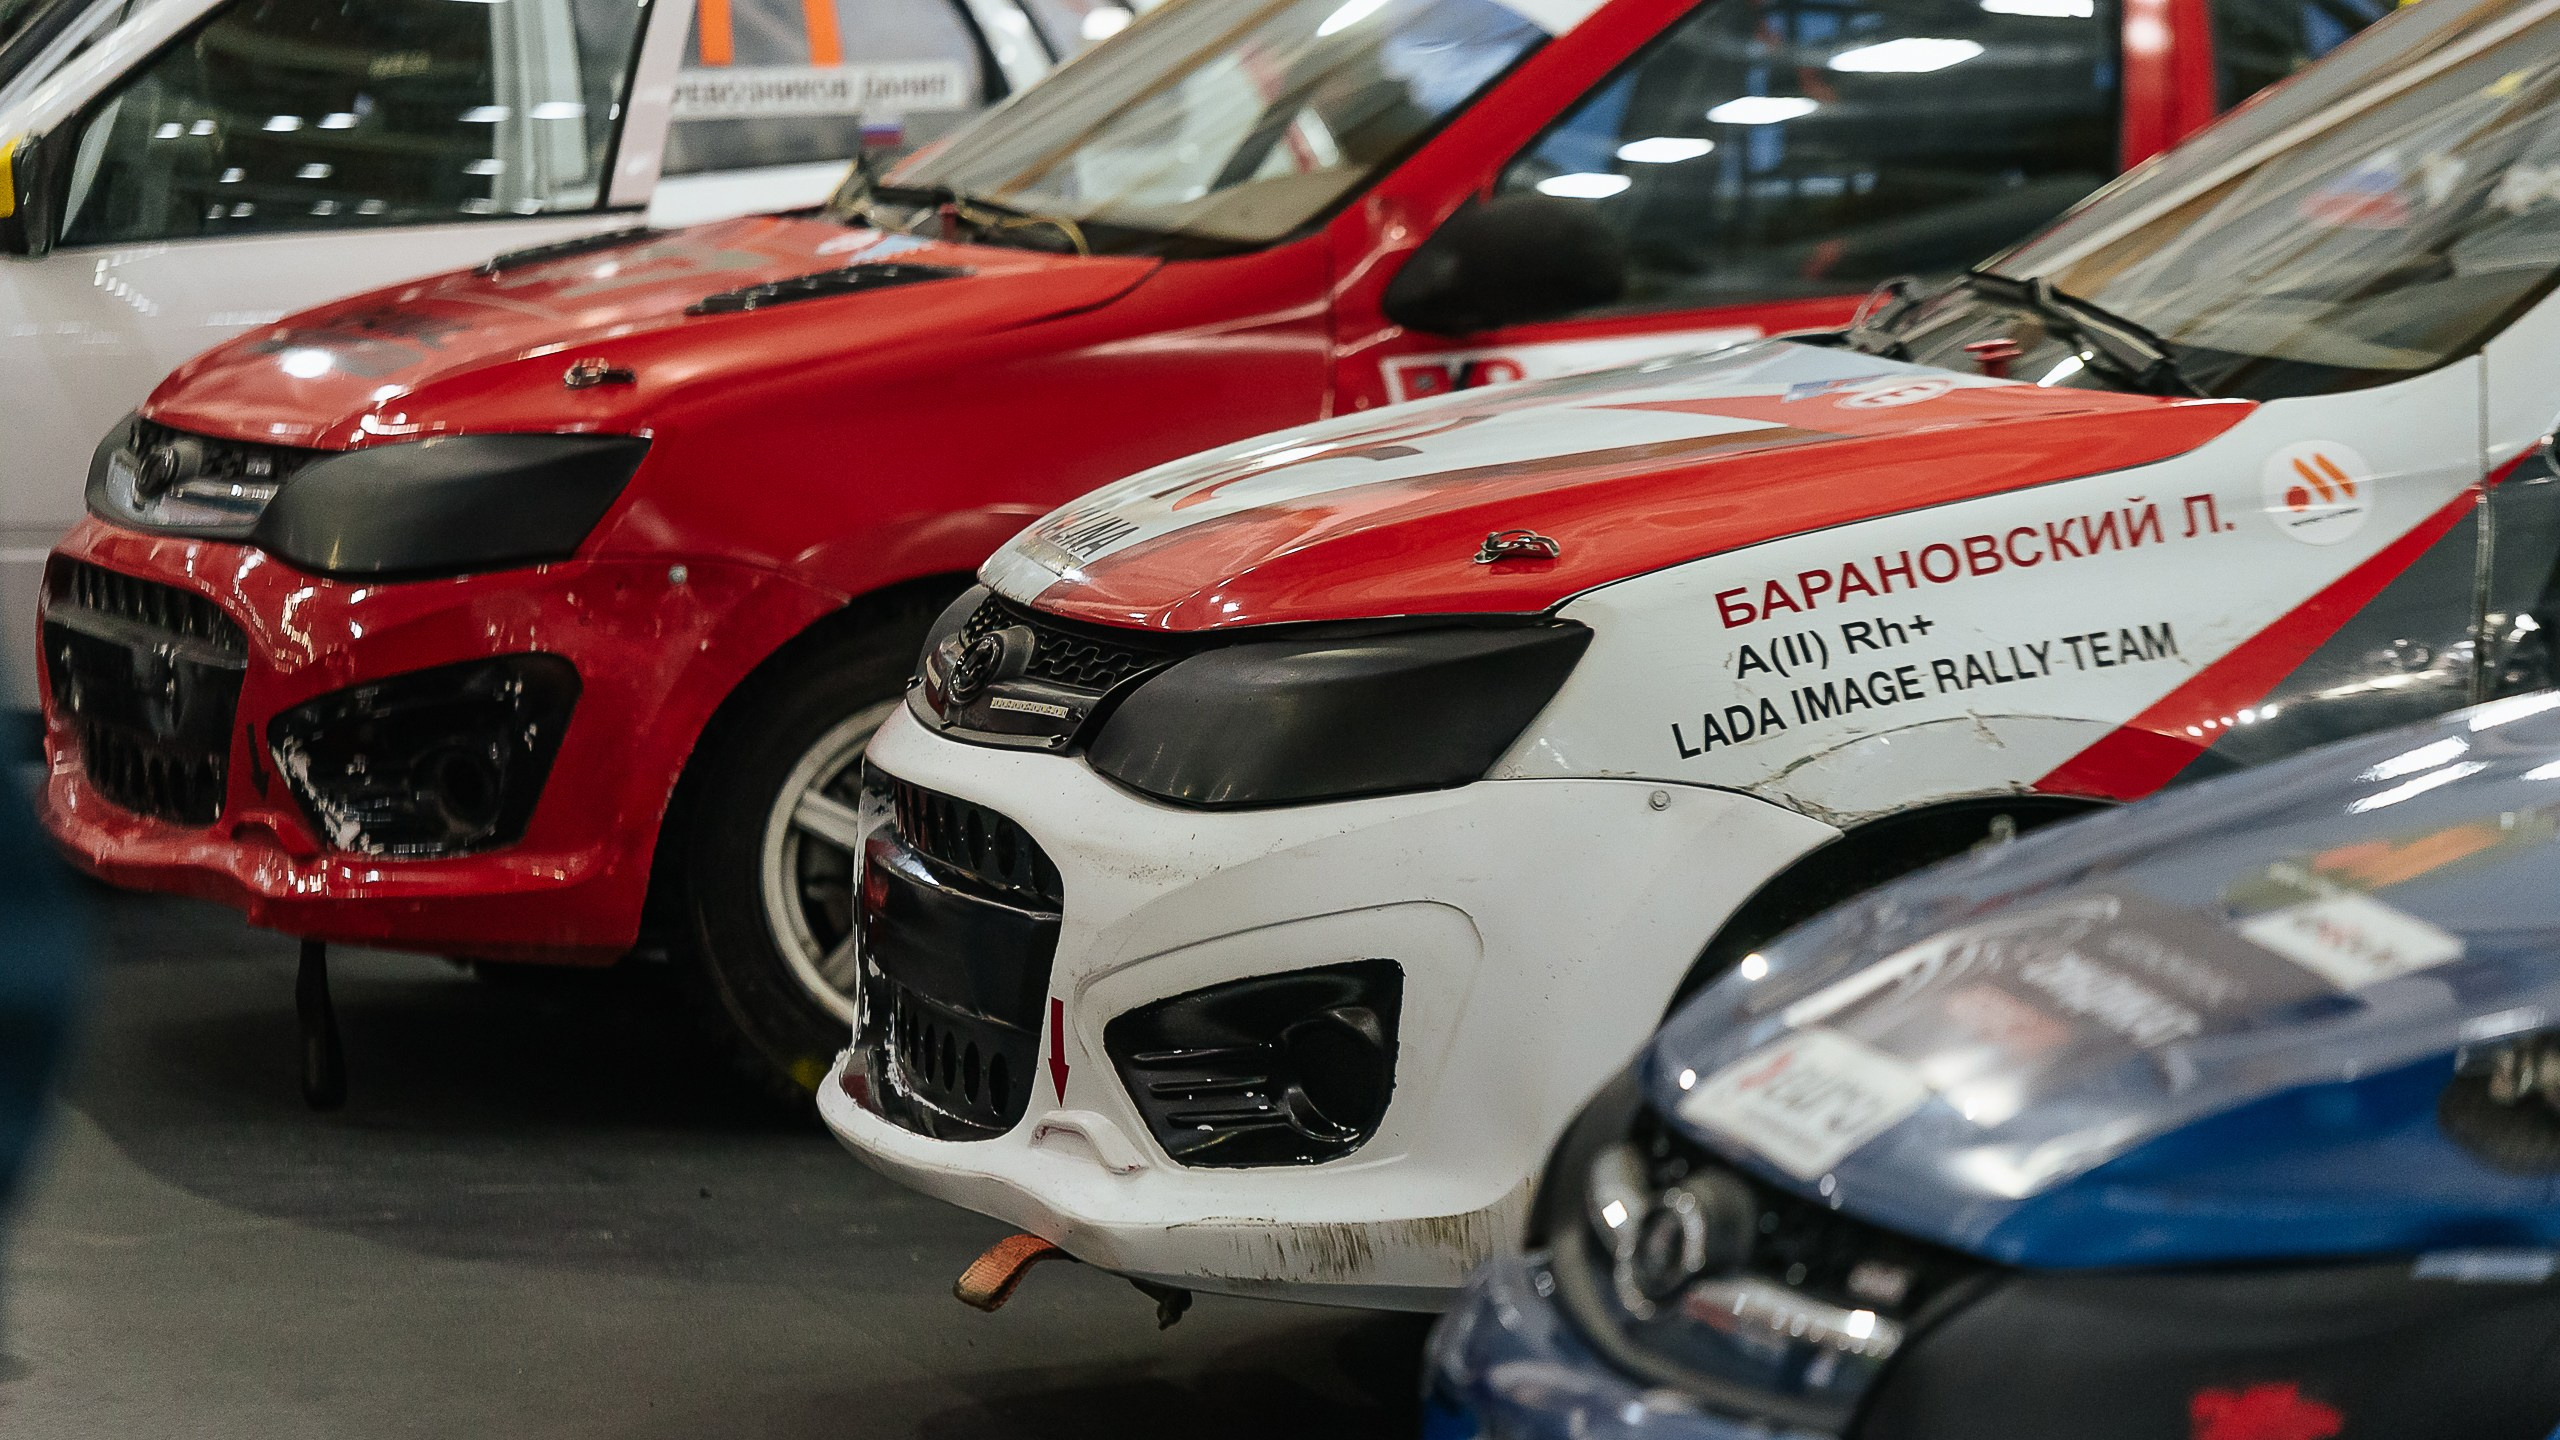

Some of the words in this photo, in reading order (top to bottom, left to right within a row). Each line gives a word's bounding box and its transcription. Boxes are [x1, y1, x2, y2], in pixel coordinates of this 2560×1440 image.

[1714, 495, 2165, 629] БАРАНОВСКИЙ
[2182, 493, 2236, 538] Л.
[1671, 697, 1788, 760] LADA
[1791, 664, 1926, 725] IMAGE
[1931, 640, 2051, 693] RALLY
[2061, 622, 2179, 671] TEAM
[1736, 630, 1830, 679] A(II)
[1840, 614, 1935, 654] Rh+
